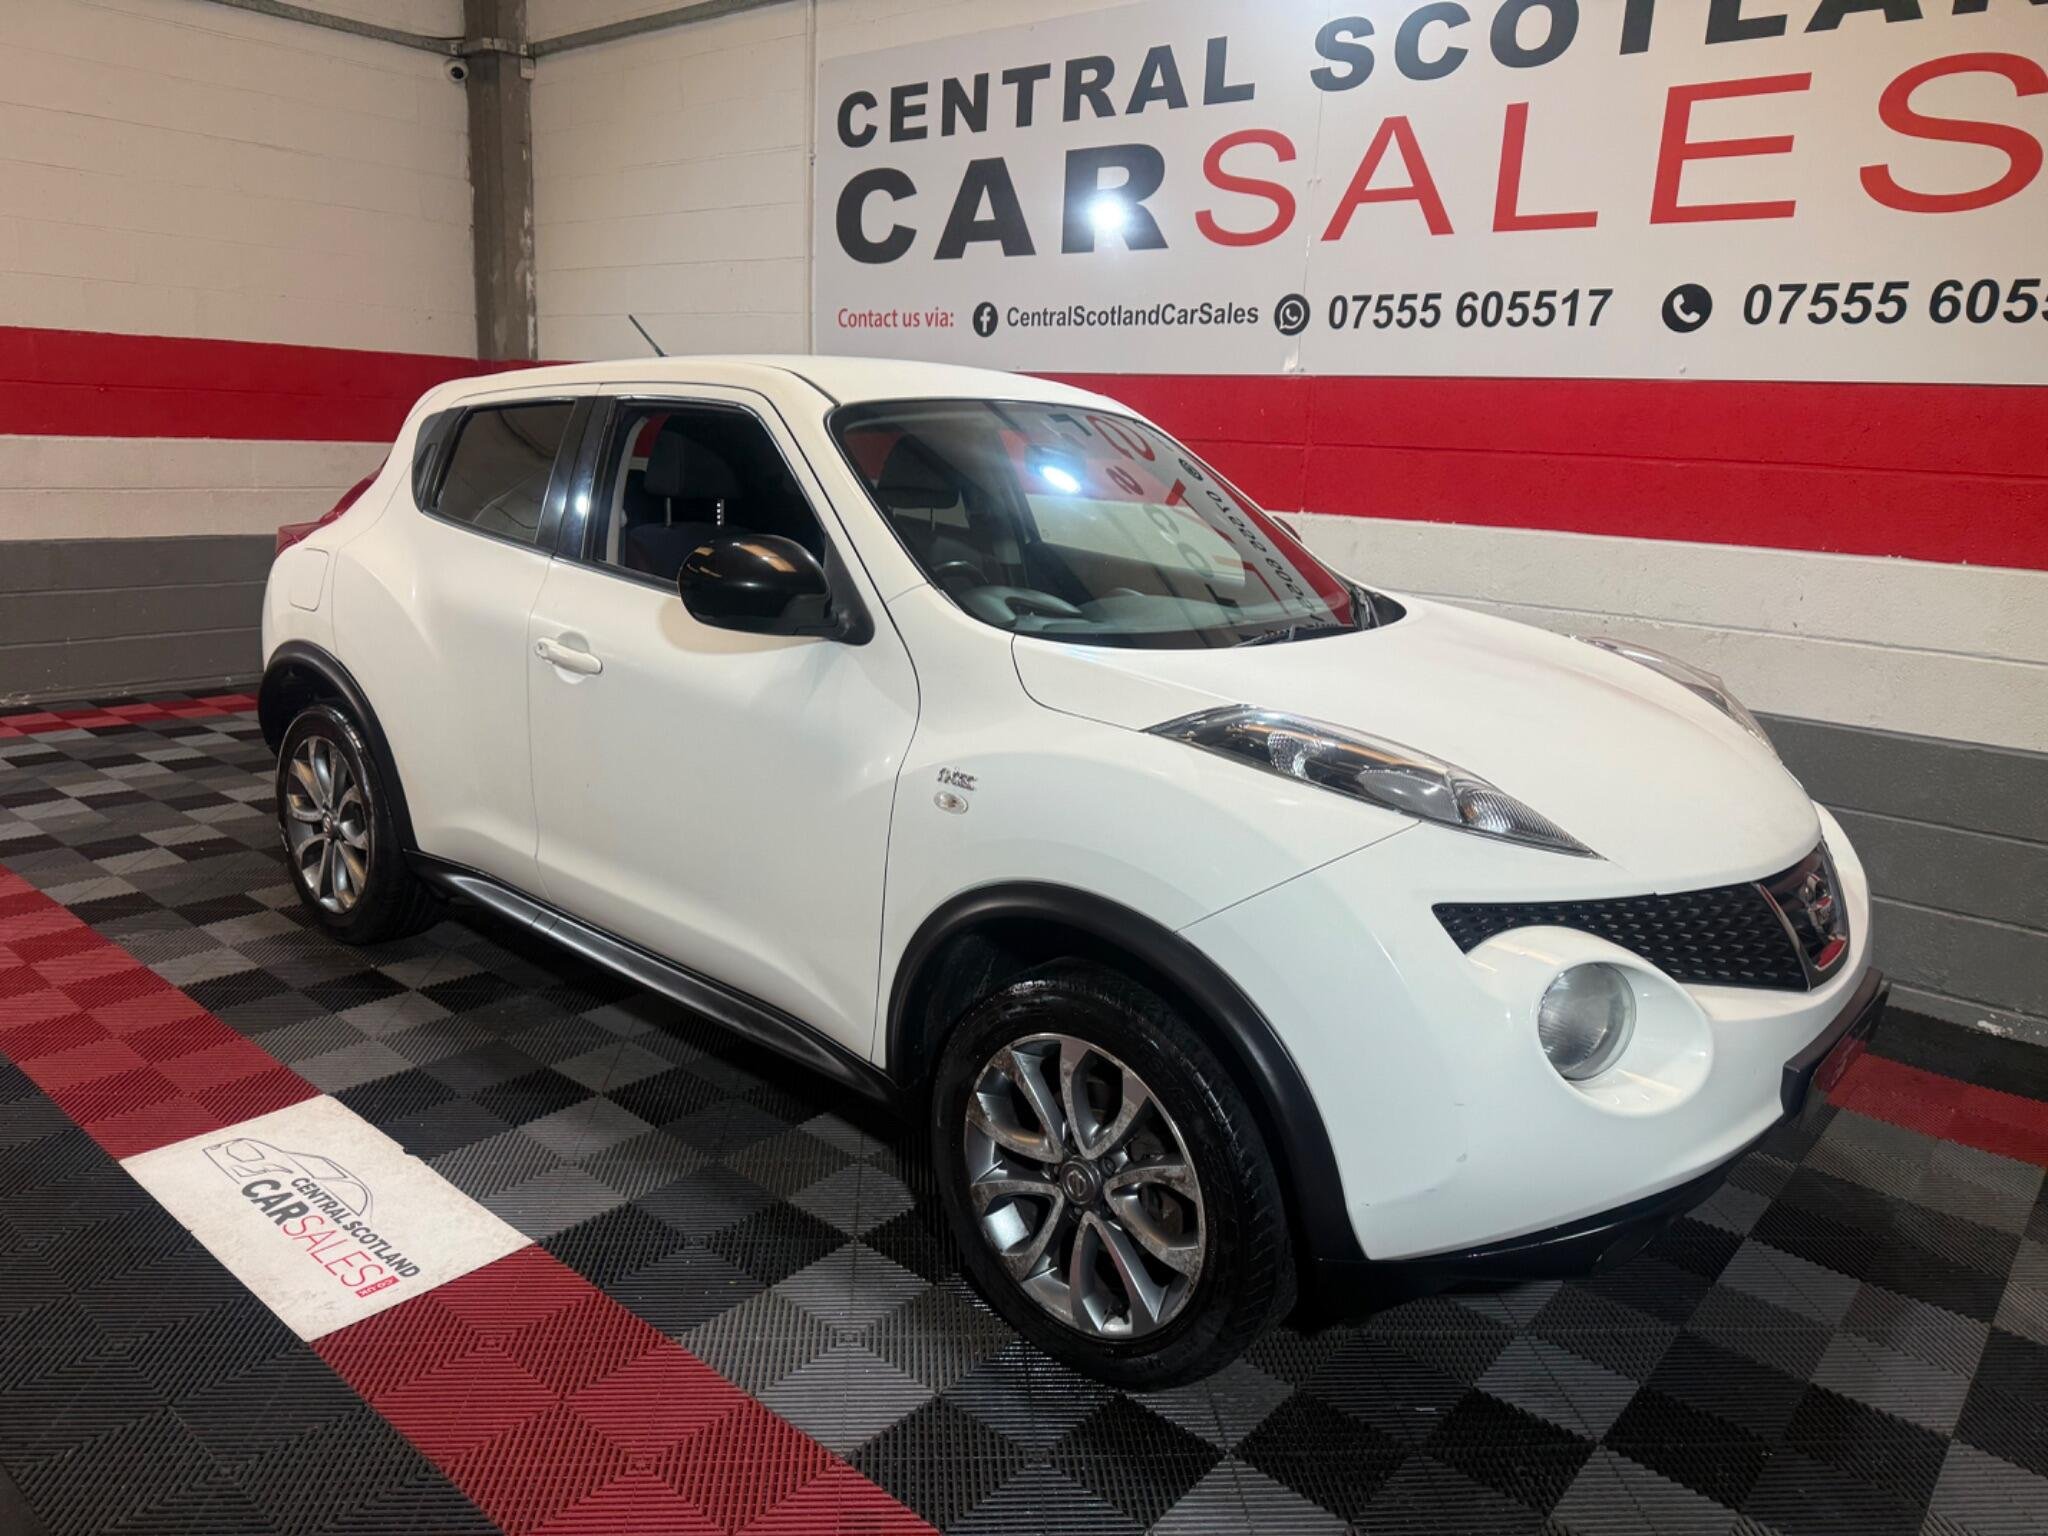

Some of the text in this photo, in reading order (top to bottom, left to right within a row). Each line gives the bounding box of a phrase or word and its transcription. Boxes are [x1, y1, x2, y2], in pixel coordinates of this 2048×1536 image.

[837, 36, 1255, 148] CENTRAL
[837, 308, 898, 329] Contact
[902, 312, 922, 329] us
[924, 307, 955, 329] via:
[1006, 302, 1259, 328] CentralScotlandCarSales
[1328, 292, 1442, 330] 07555
[1455, 288, 1614, 328] 605517
[1743, 281, 1910, 325] 07555
[1929, 278, 2048, 324] 605
[290, 1177, 421, 1278] CENTRAL SCOTLAND
